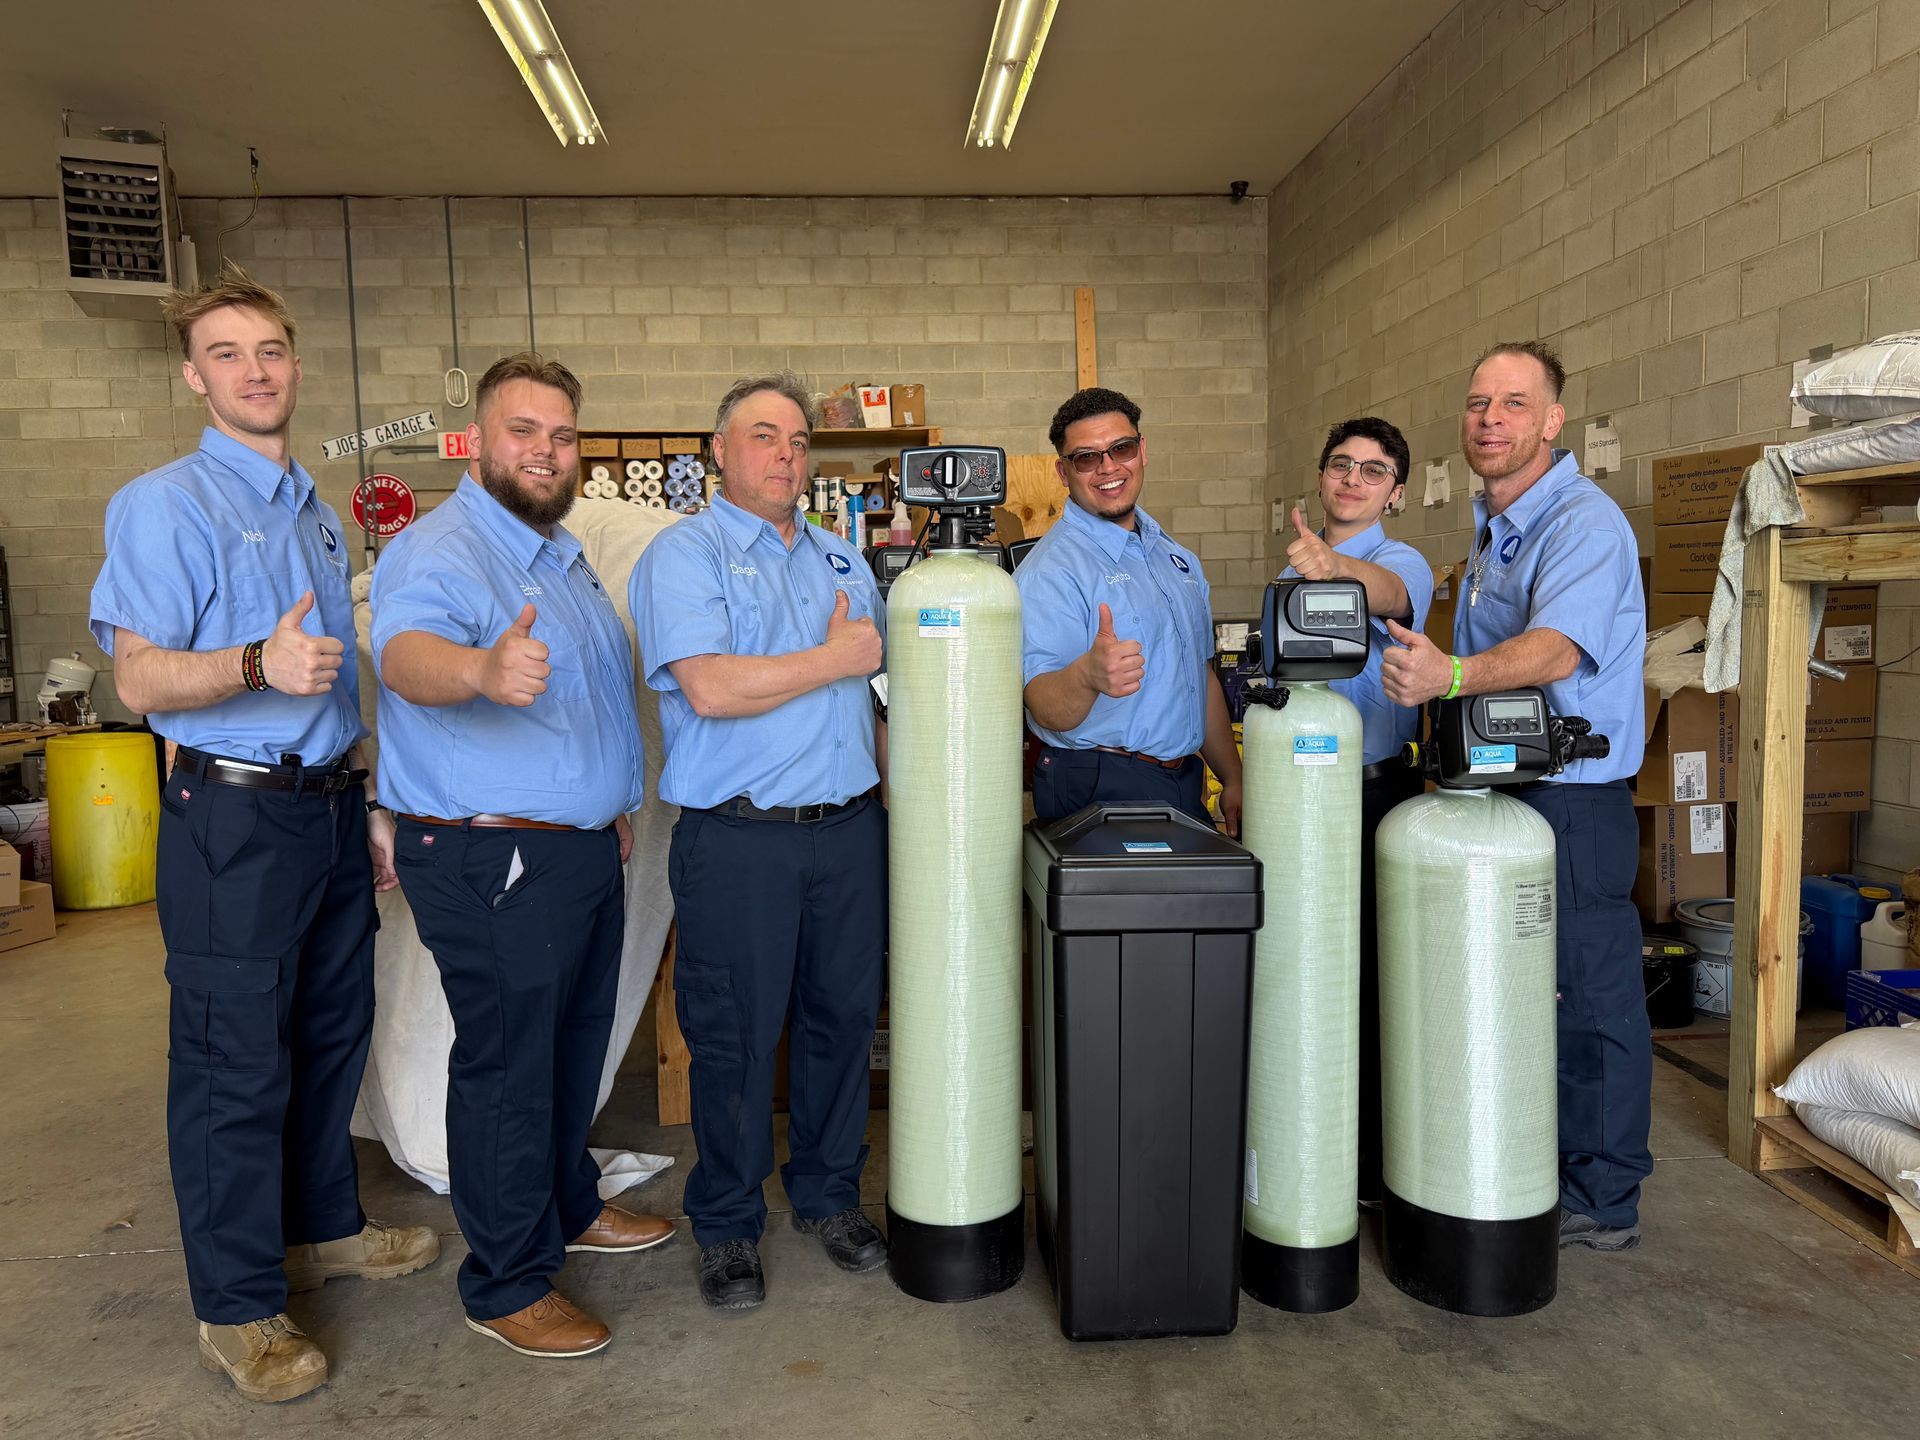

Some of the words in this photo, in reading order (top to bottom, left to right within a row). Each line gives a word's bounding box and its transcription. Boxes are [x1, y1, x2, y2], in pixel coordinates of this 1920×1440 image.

[335, 432, 368, 456] JOE'S
[375, 415, 426, 443] GARAGE
[445, 433, 468, 457] EXI
[1668, 473, 1686, 481] Another
[1687, 471, 1702, 480] quality
[241, 528, 267, 544] Nick
[729, 563, 758, 576] Dags
[1850, 716, 1872, 724] TESTED
[1843, 790, 1865, 798] TESTED
[1668, 808, 1676, 842] DESIGNED,
